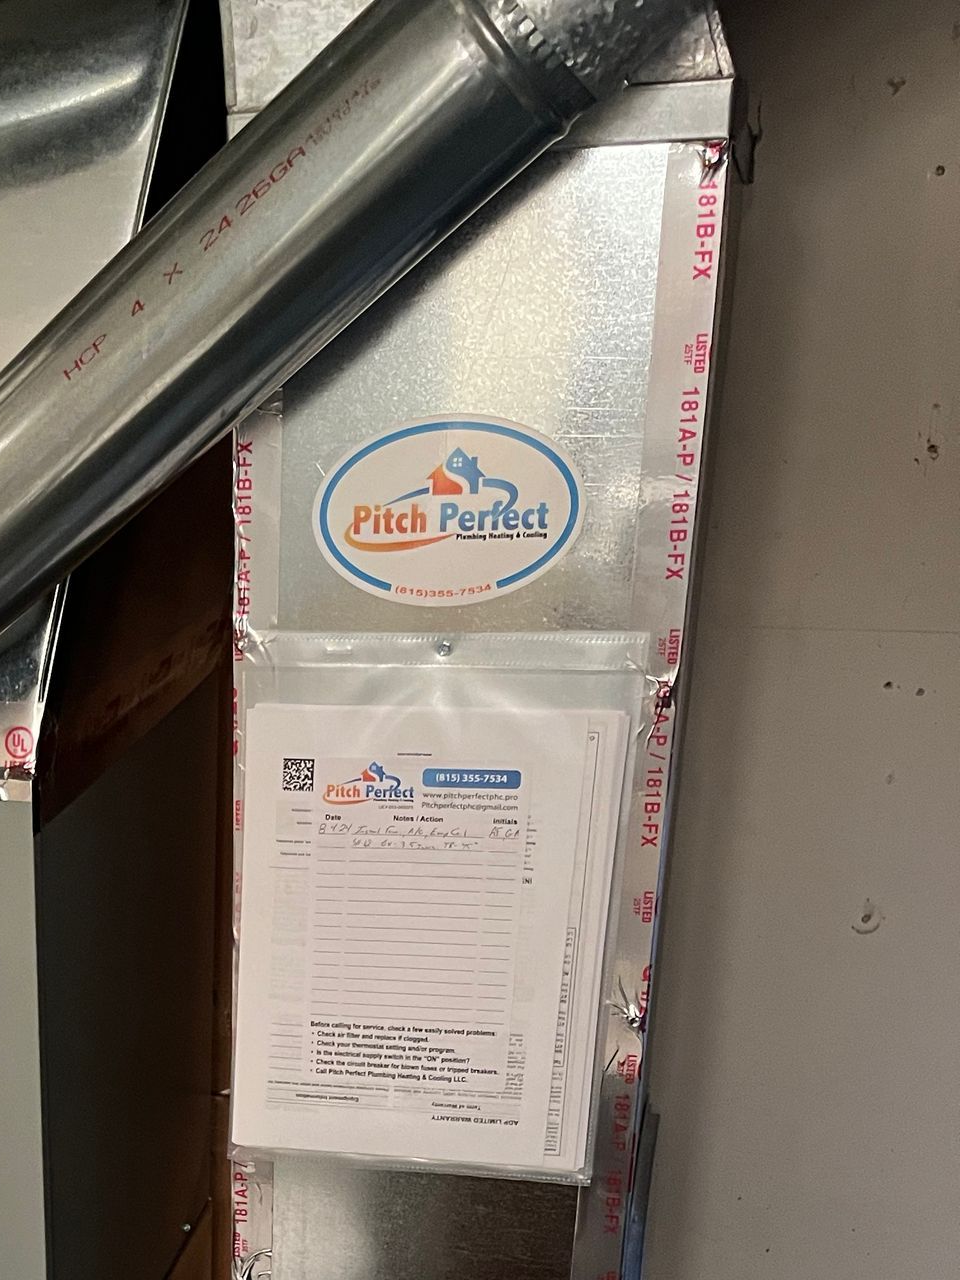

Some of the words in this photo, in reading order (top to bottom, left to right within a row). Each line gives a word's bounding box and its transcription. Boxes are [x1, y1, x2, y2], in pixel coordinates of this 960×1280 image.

[692, 180, 718, 281] 181B-FX
[63, 333, 107, 380] HCP
[131, 299, 145, 317] 4
[163, 261, 184, 285] X
[199, 215, 234, 251] 24
[235, 146, 307, 217] 26GA
[693, 332, 708, 374] LISTED
[676, 386, 700, 467] 181A-P
[236, 440, 253, 527] 181B-FX
[674, 474, 693, 482] /
[352, 503, 428, 536] Pitch
[439, 501, 549, 533] Perfect
[455, 532, 487, 541] Plumbing
[488, 532, 515, 541] Heating
[522, 531, 548, 540] Cooling
[665, 489, 691, 580] 181B-FX
[394, 582, 493, 598] (815)355-7534
[666, 628, 681, 665] LISTED
[435, 770, 461, 784] (815)
[461, 771, 508, 784] 355-7534
[326, 783, 361, 799] Pitch
[365, 784, 415, 800] Perfect
[422, 792, 519, 801] www.pitchperfectphc.pro
[421, 801, 519, 811] Pitchperfectphc@gmail.com
[640, 767, 664, 848] 181B-FX
[393, 814, 415, 822] Notes
[419, 815, 444, 823] Action
[641, 890, 654, 924] LISTED
[331, 1022, 351, 1030] calling
[424, 1027, 442, 1035] easily
[351, 1042, 384, 1050] thermostat
[367, 1070, 396, 1080] Plumbing
[397, 1073, 421, 1081] Heating
[428, 1074, 452, 1083] Cooling
[470, 1067, 498, 1075] breakers.
[625, 1054, 639, 1085] LISTED
[431, 1114, 472, 1123] WARRANTY
[473, 1117, 502, 1125] LIMITED
[234, 1171, 249, 1225] 181A-P
